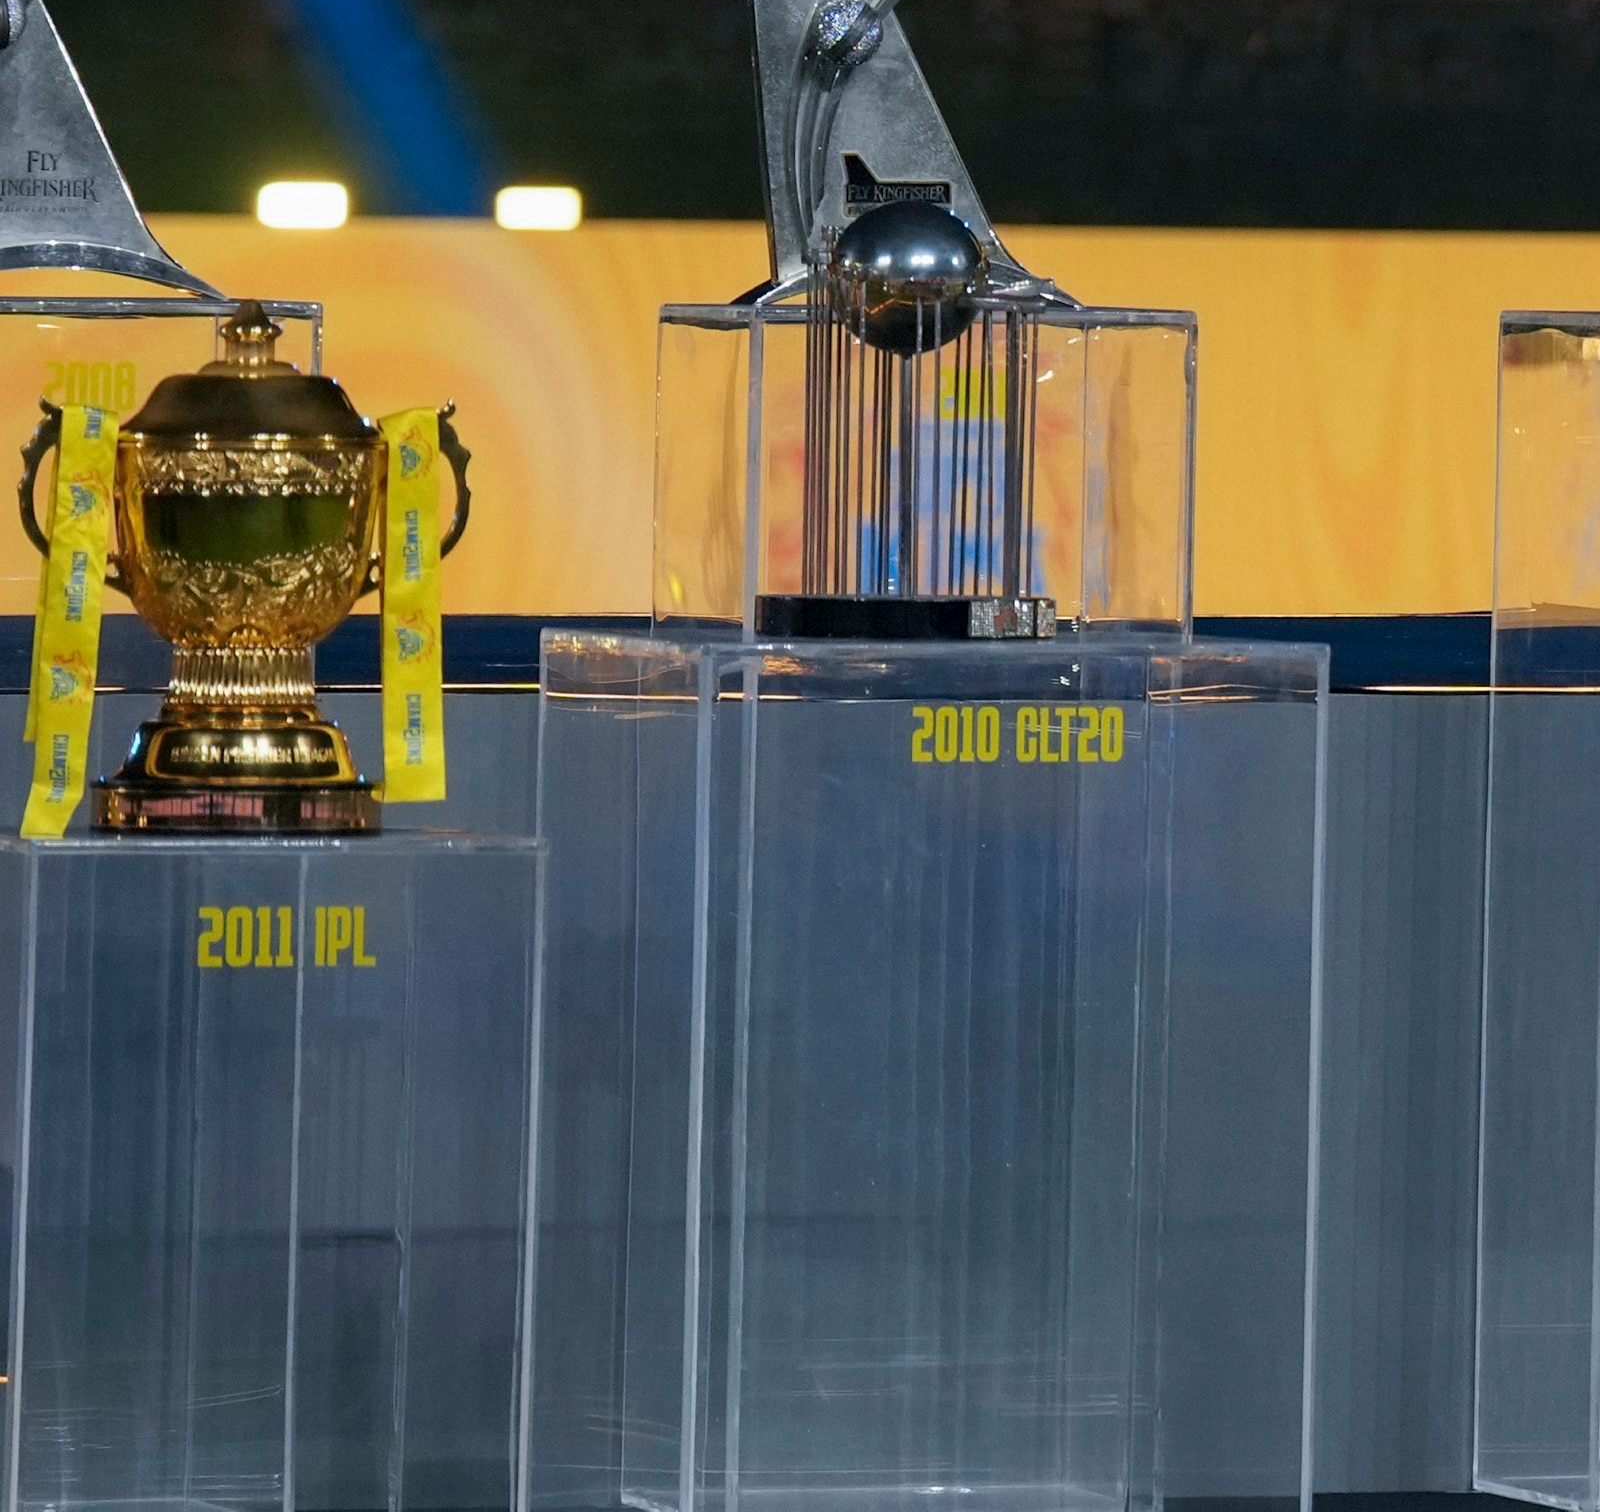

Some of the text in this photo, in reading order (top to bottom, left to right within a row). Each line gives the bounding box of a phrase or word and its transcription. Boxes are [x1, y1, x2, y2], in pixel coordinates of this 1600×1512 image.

[27, 150, 60, 173] FLY
[0, 177, 100, 203] INGFISHER
[847, 184, 946, 204] FLY KINGFISHER
[43, 360, 137, 412] 2008
[912, 705, 1125, 763] 2010 CLT20
[197, 906, 377, 968] 2011 IPL
